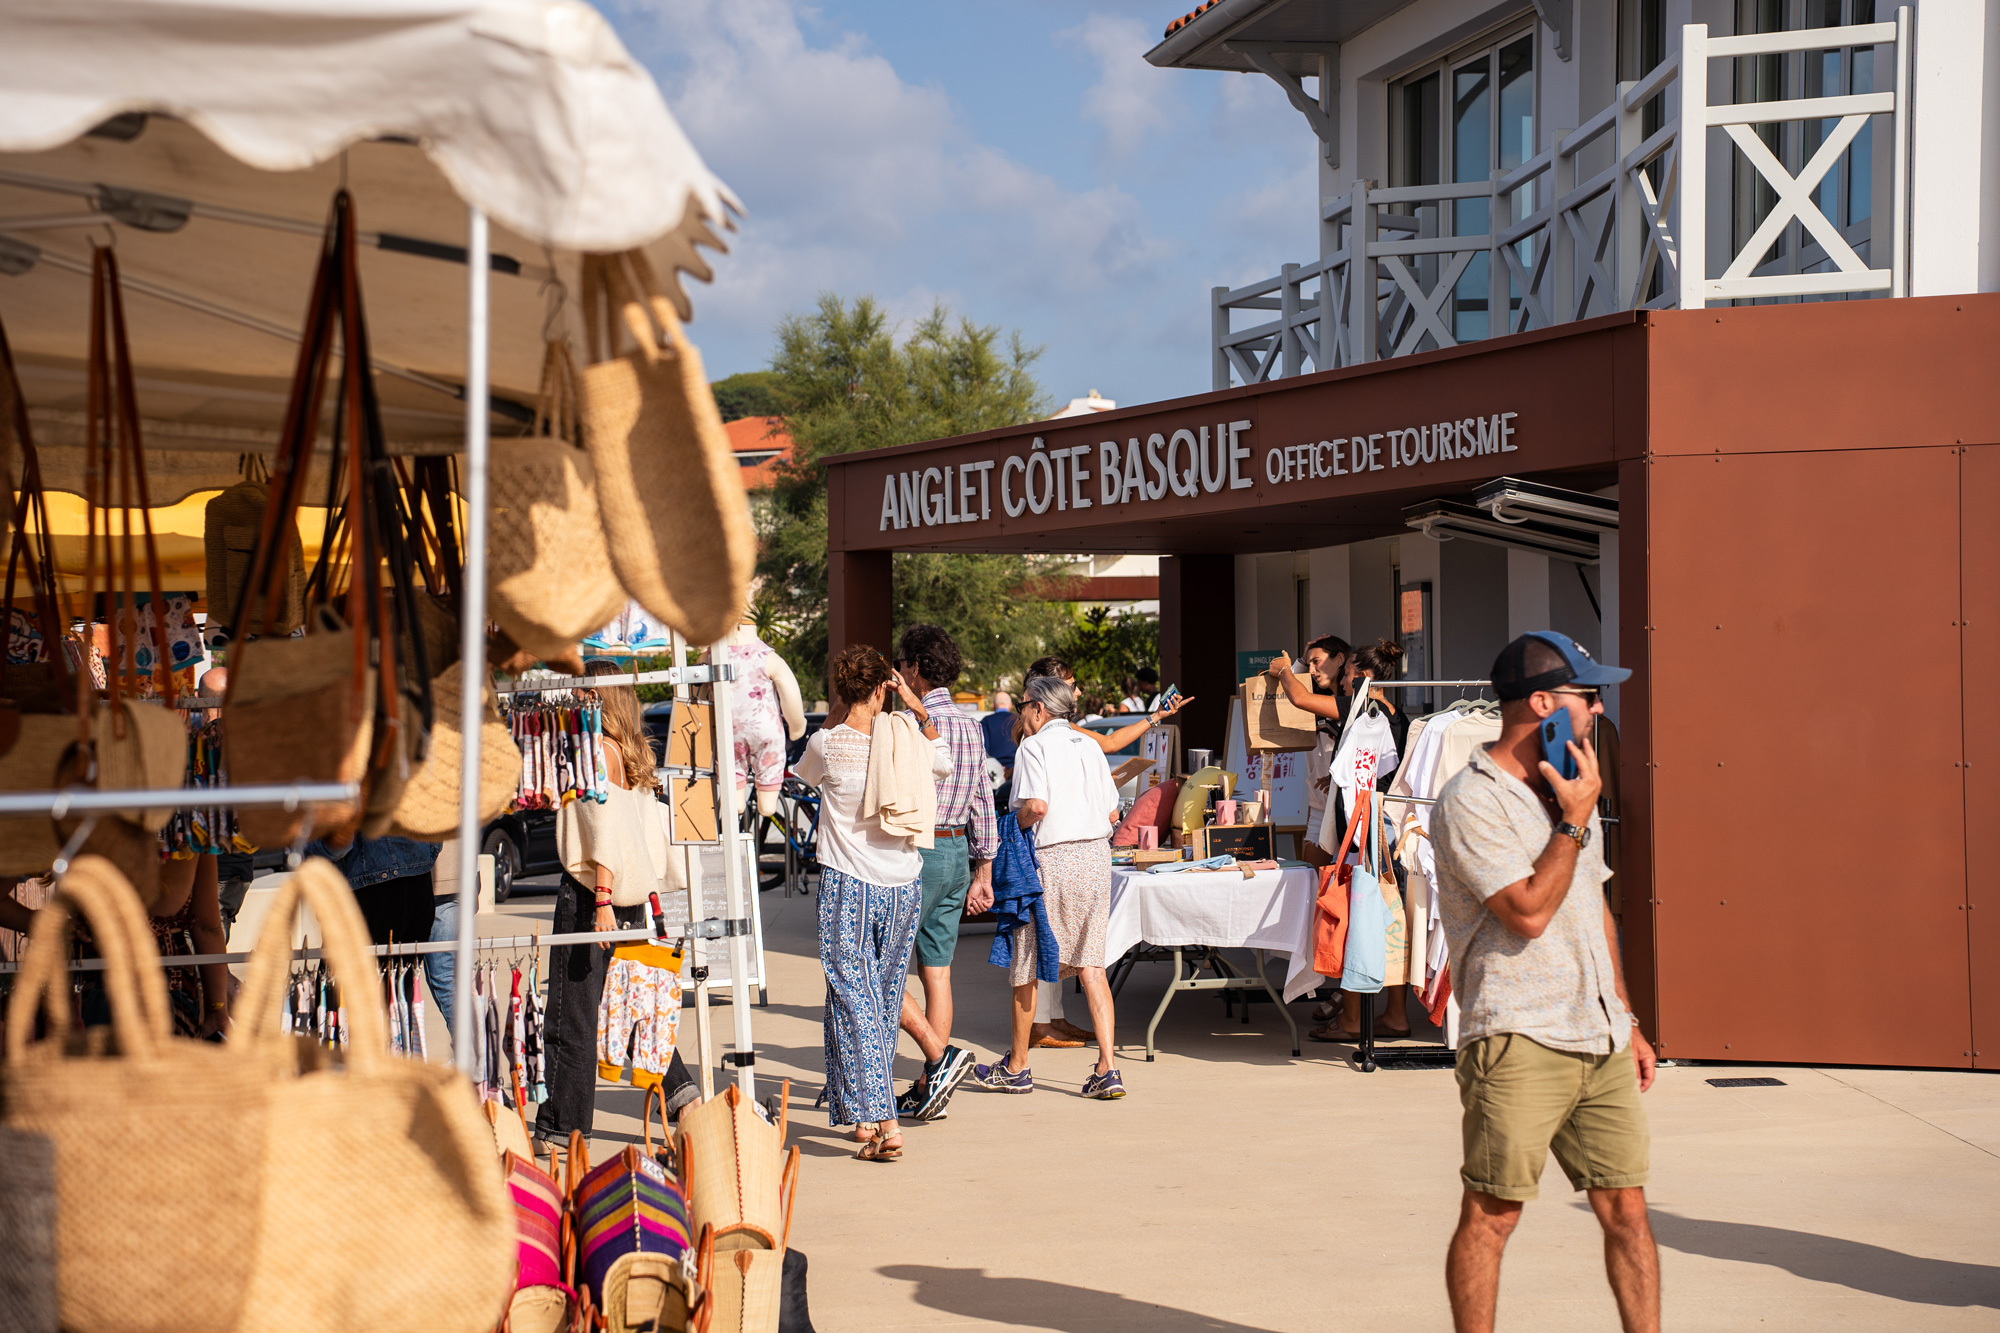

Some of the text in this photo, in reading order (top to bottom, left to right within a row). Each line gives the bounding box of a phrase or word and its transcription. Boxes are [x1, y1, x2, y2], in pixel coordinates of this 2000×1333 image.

[880, 411, 1518, 531] ANGLET CÔTE BASQUE OFFICE DE TOURISME
[1252, 692, 1263, 701] La
